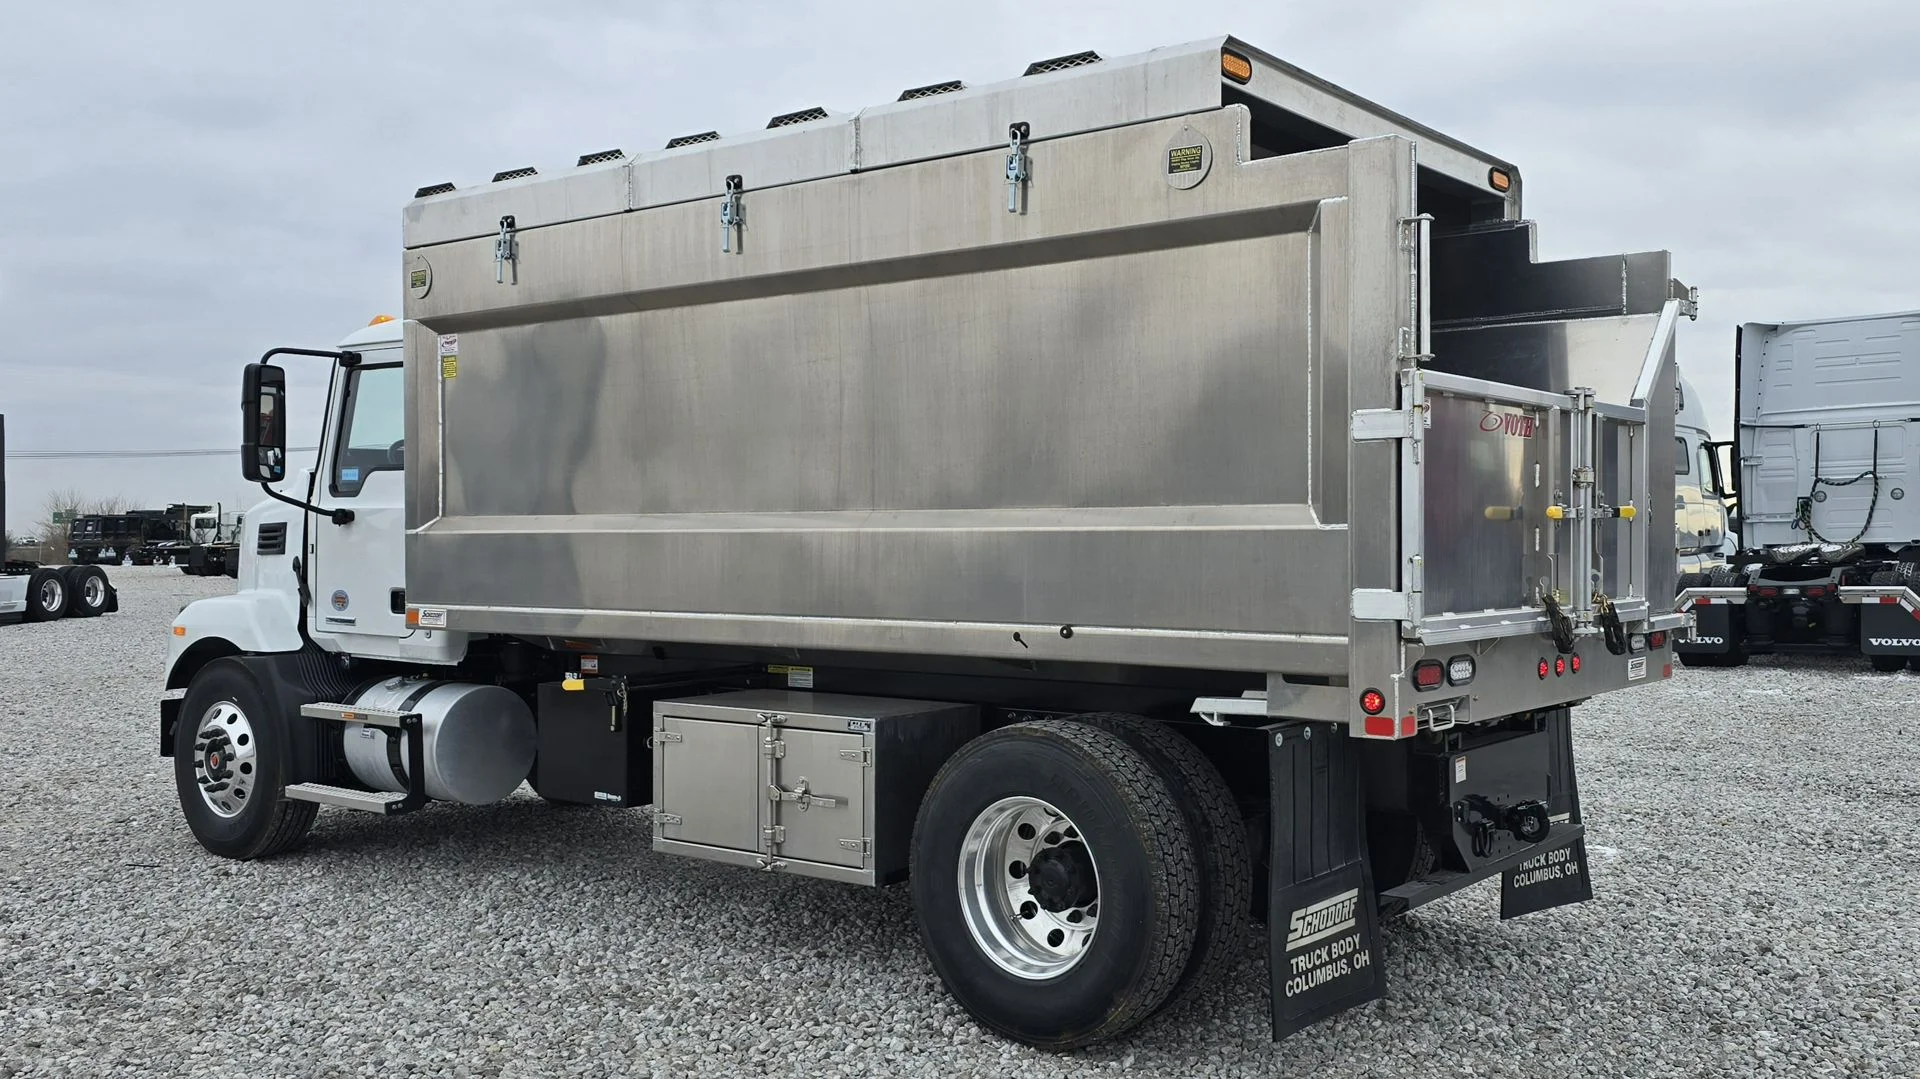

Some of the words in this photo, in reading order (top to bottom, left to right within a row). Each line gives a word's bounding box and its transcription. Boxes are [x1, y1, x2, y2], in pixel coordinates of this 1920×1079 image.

[1171, 147, 1201, 157] WARNING
[1869, 638, 1920, 646] VOLVO
[1548, 848, 1571, 866] BODY
[1513, 866, 1563, 888] COLUMBUS,
[1565, 861, 1578, 876] OH
[1287, 896, 1358, 942] SCHODORF
[1290, 945, 1330, 975] TRUCK
[1331, 933, 1360, 959] BODY
[1285, 958, 1351, 998] COLUMBUS,
[1353, 949, 1370, 969] OH
